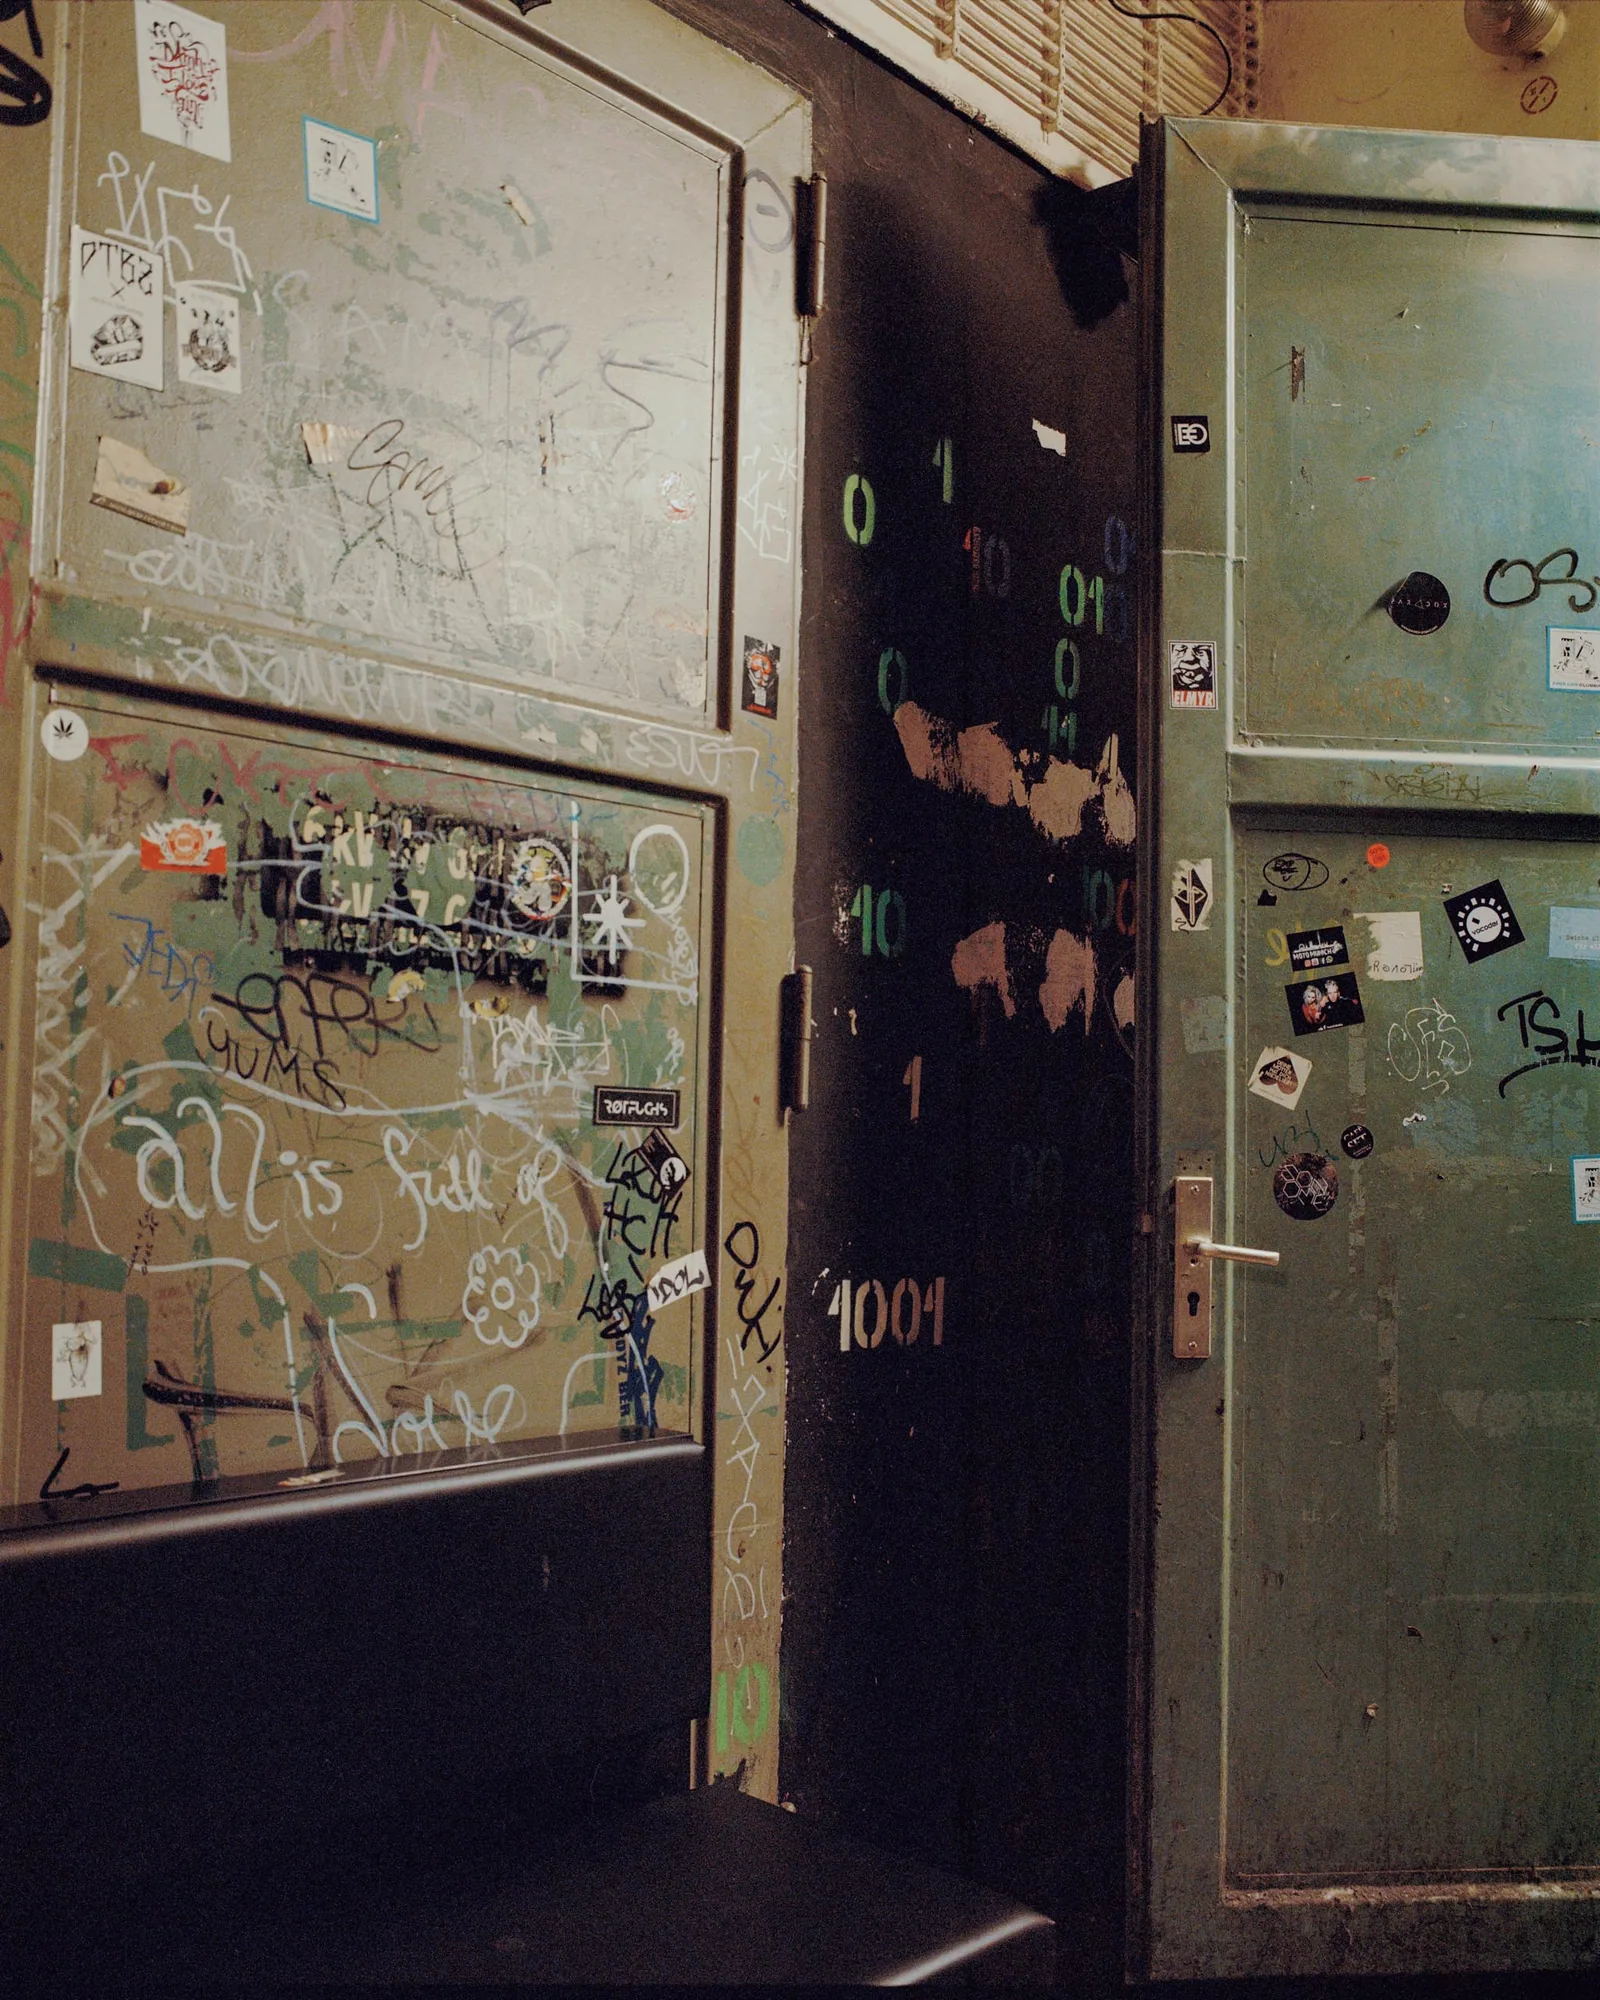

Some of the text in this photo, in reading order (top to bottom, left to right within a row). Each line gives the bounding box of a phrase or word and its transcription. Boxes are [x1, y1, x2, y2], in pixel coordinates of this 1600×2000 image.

[1173, 690, 1214, 707] ELMYR
[1293, 951, 1310, 960] MOTO
[279, 1151, 342, 1219] is
[384, 1124, 494, 1251] full
[828, 1276, 945, 1352] 1001
